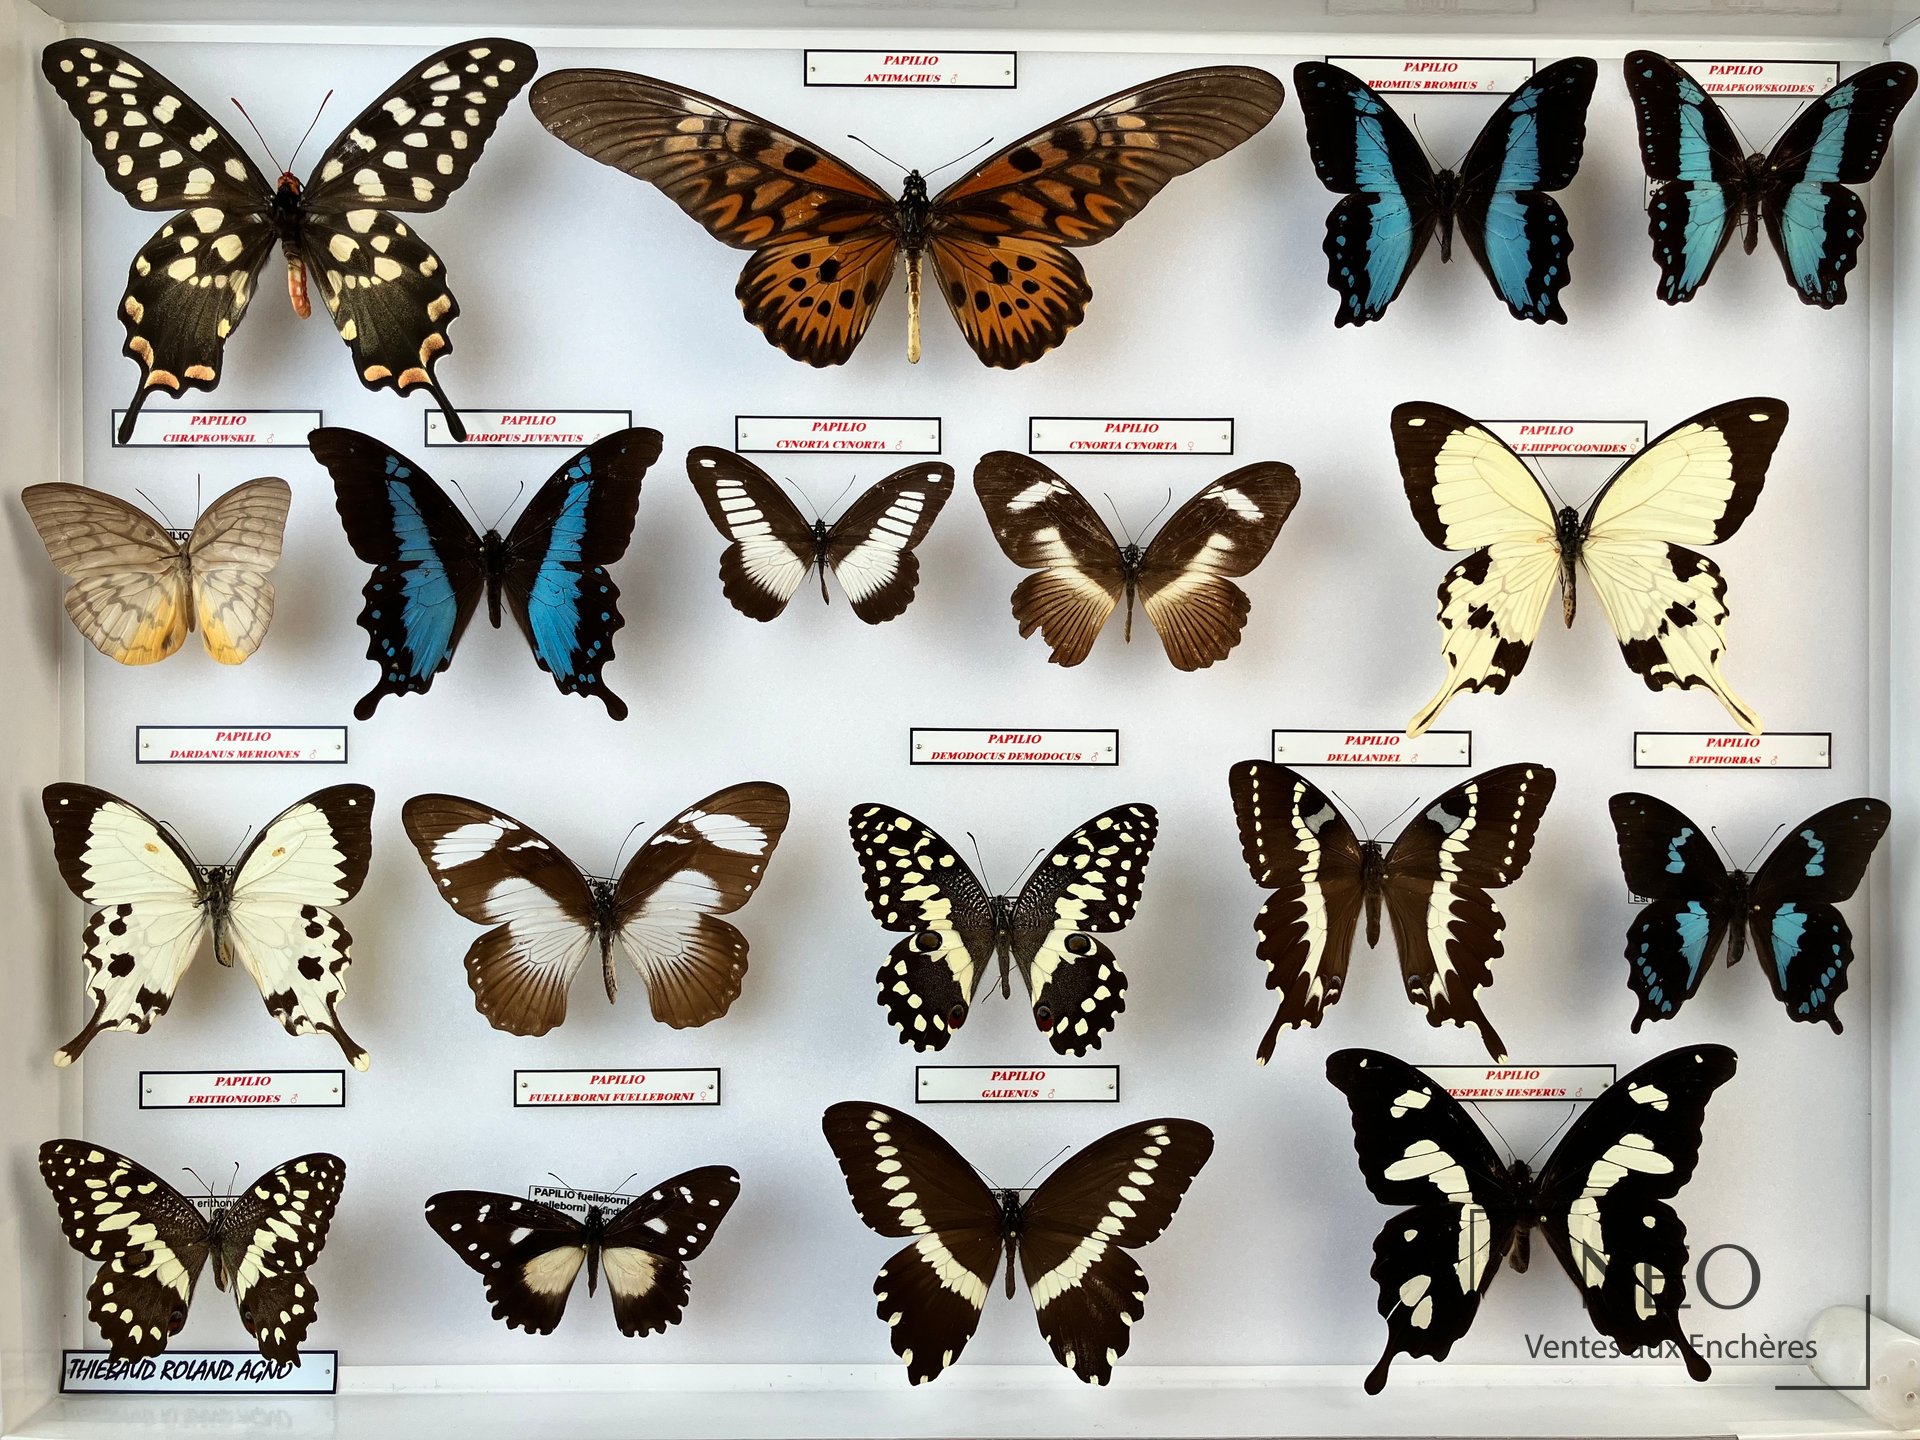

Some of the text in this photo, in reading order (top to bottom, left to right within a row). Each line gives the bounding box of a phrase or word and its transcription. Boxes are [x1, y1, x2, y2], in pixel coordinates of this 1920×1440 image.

[884, 55, 940, 66] PAPILIO
[1404, 62, 1459, 73] PAPILIO
[1708, 65, 1764, 76] PAPILIO
[865, 73, 942, 83] ANTIMACHUS
[1368, 79, 1478, 90] BROMIUS BROMIUS
[190, 415, 247, 426] PAPILIO
[501, 415, 557, 426] PAPILIO
[811, 422, 868, 433] PAPILIO
[1104, 423, 1160, 434] PAPILIO
[1519, 426, 1575, 436] PAPILIO
[466, 433, 584, 443] HAROPUS JUVENTUS
[776, 439, 886, 449] CYNORTA CYNORTA
[1068, 440, 1178, 450] CYNORTA CYNORTA
[214, 731, 272, 742] PAPILIO
[988, 734, 1043, 745] PAPILIO
[1345, 736, 1401, 746] PAPILIO
[1706, 737, 1761, 748] PAPILIO
[170, 749, 300, 759] DARDANUS MERIONES
[931, 751, 1083, 761] DEMODOCUS DEMODOCUS
[1688, 755, 1762, 765] EPIPHORBAS
[589, 1074, 646, 1085] PAPILIO
[991, 1071, 1047, 1082] PAPILIO
[1486, 1070, 1541, 1081] PAPILIO
[214, 1076, 272, 1087] PAPILIO
[529, 1091, 696, 1102] FUELLEBORNI FUELLEBORNI
[981, 1089, 1040, 1099] GALIENUS
[1506, 1087, 1567, 1097] HESPERUS
[188, 1094, 282, 1104] ERITHONIODES
[534, 1187, 630, 1206] PAPILIO fuelleborni
[160, 1358, 234, 1381] ROLAND
